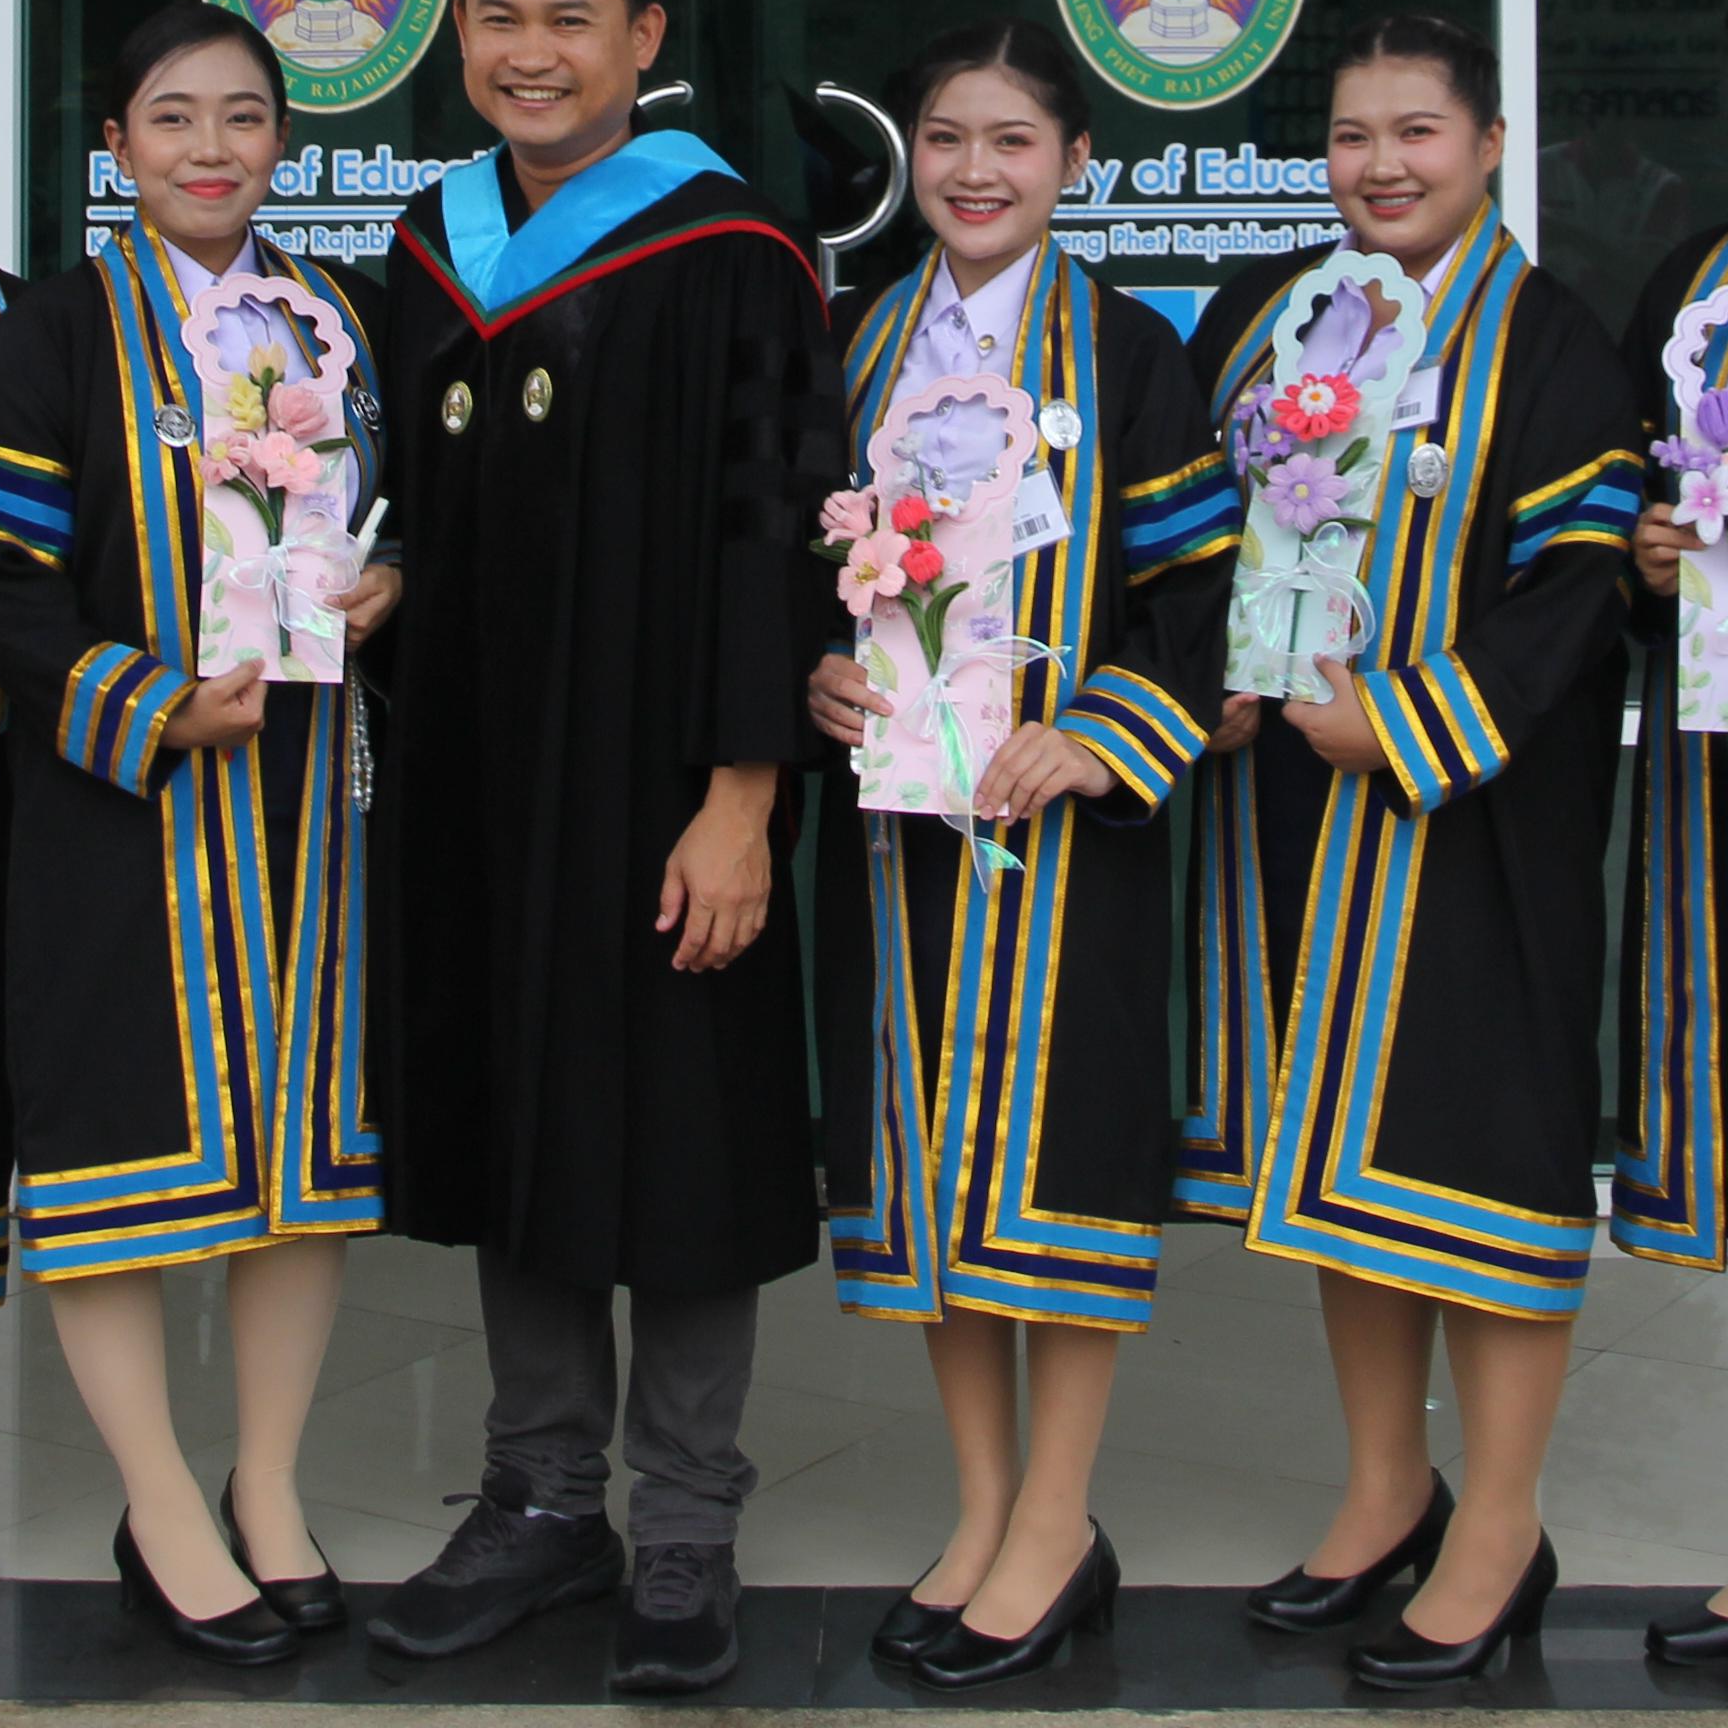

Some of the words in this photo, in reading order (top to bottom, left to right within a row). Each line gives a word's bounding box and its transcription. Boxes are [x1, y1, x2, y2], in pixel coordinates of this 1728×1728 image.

[311, 42, 408, 101] RAJABHAT
[1104, 47, 1152, 85] PHET
[1164, 39, 1265, 97] RAJABHAT
[272, 144, 324, 196] of
[1133, 143, 1187, 195] of
[1110, 222, 1170, 255] Phet
[1173, 222, 1296, 262] Rajabhat
